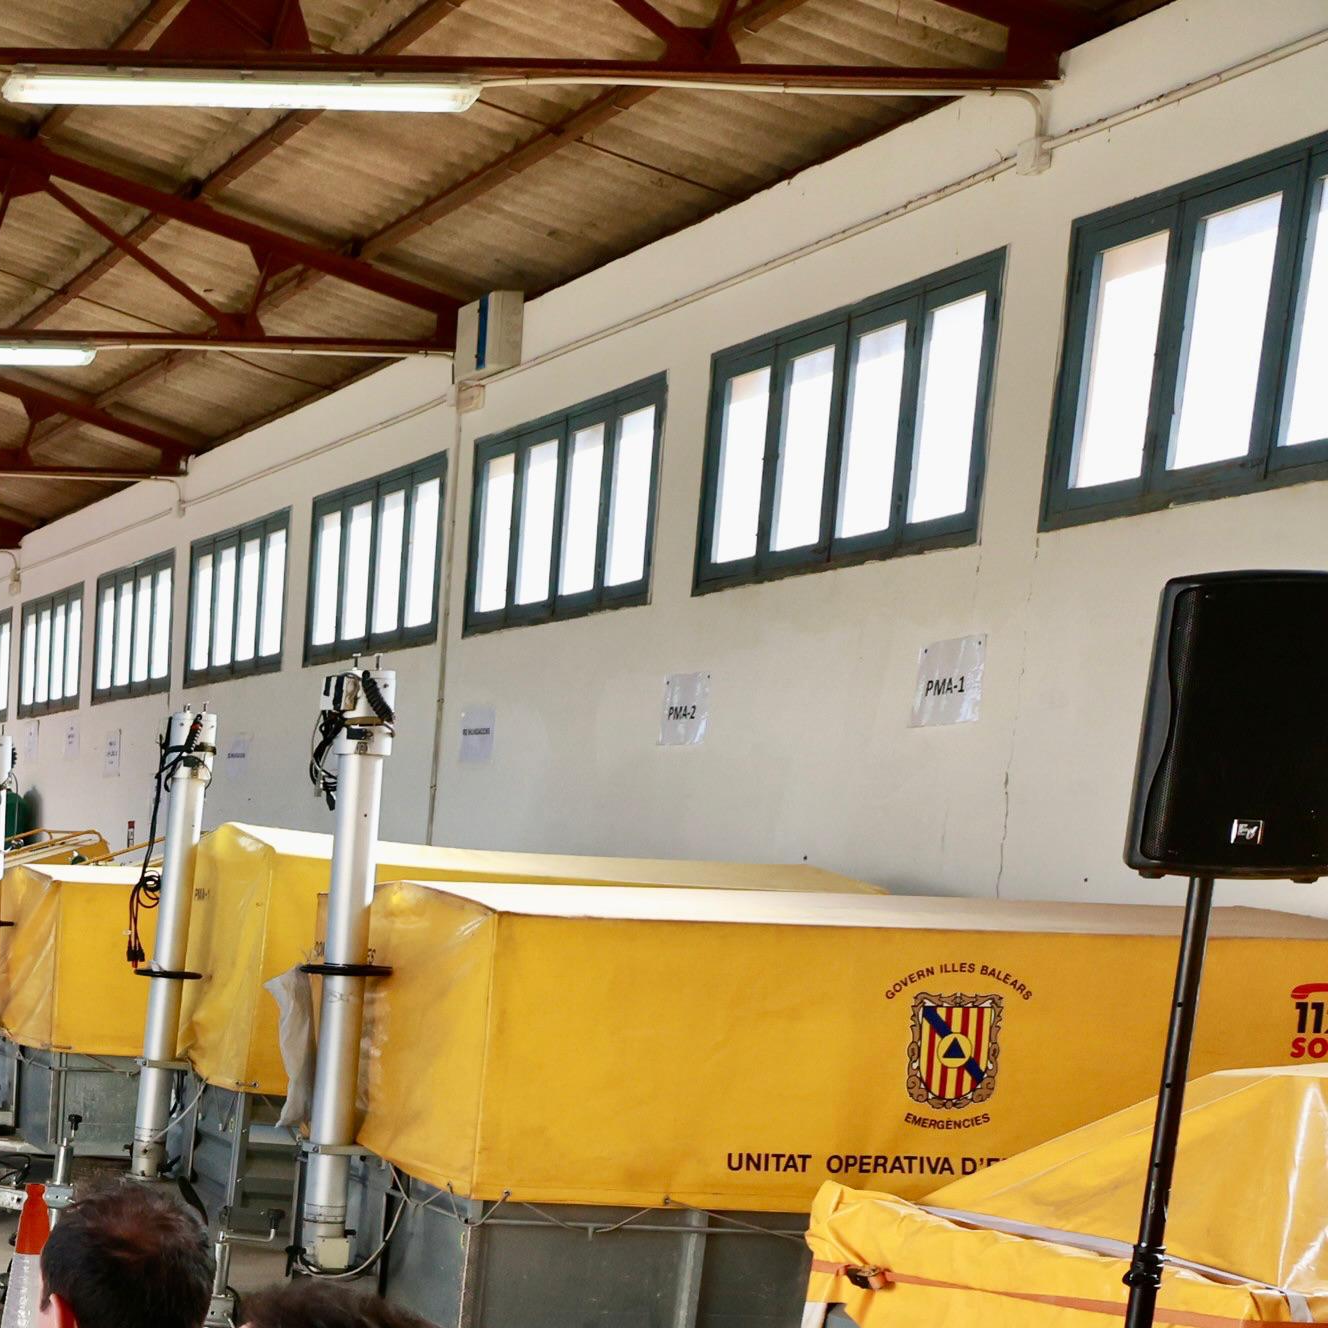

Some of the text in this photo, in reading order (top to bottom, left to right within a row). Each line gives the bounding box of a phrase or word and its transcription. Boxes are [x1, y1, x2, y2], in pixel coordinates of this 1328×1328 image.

[925, 676, 965, 696] PMA-1
[667, 705, 697, 720] PMA-2
[885, 963, 1033, 1001] GOVERN ILLES BALEARS
[1295, 1001, 1328, 1034] 11
[727, 1152, 812, 1173] UNITAT
[826, 1155, 955, 1175] OPERATIVA
